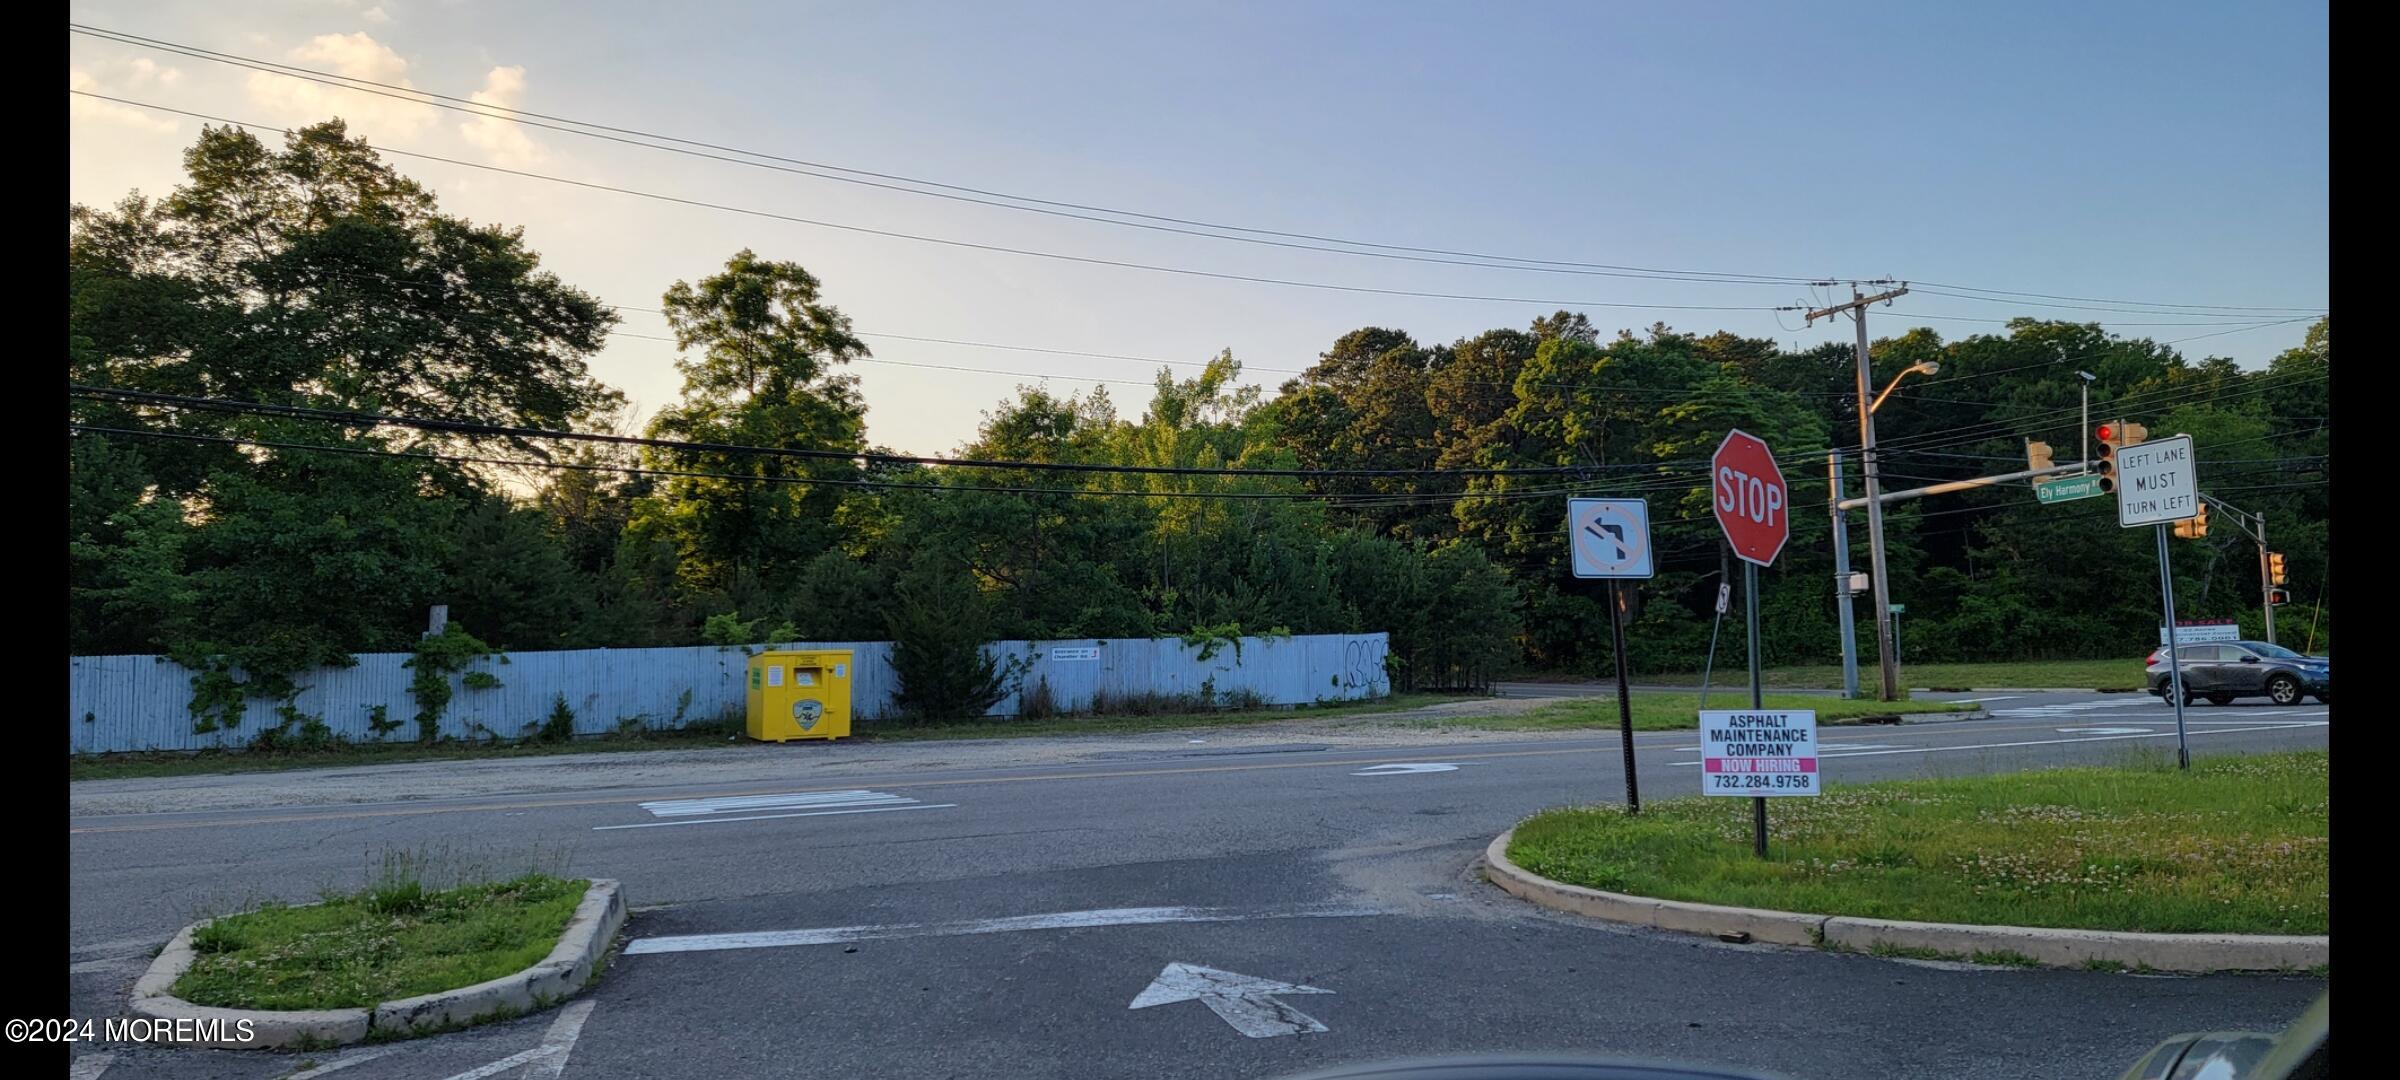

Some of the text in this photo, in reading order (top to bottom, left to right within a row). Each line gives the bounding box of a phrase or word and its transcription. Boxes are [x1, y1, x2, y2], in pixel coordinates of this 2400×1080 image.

[2123, 447, 2186, 469] LEFT LANE
[2136, 472, 2176, 492] MUST
[1719, 466, 1782, 527] STOP
[2040, 487, 2053, 500] Ely
[2056, 482, 2091, 497] Harmony
[2127, 495, 2191, 515] TURN LEFT
[1729, 715, 1788, 728] ASPHALT
[1710, 729, 1808, 742] MAINTENANCE
[1726, 743, 1793, 756] COMPANY
[1721, 759, 1801, 772] NOW HIRING
[1714, 775, 1809, 788] 732.284.9758
